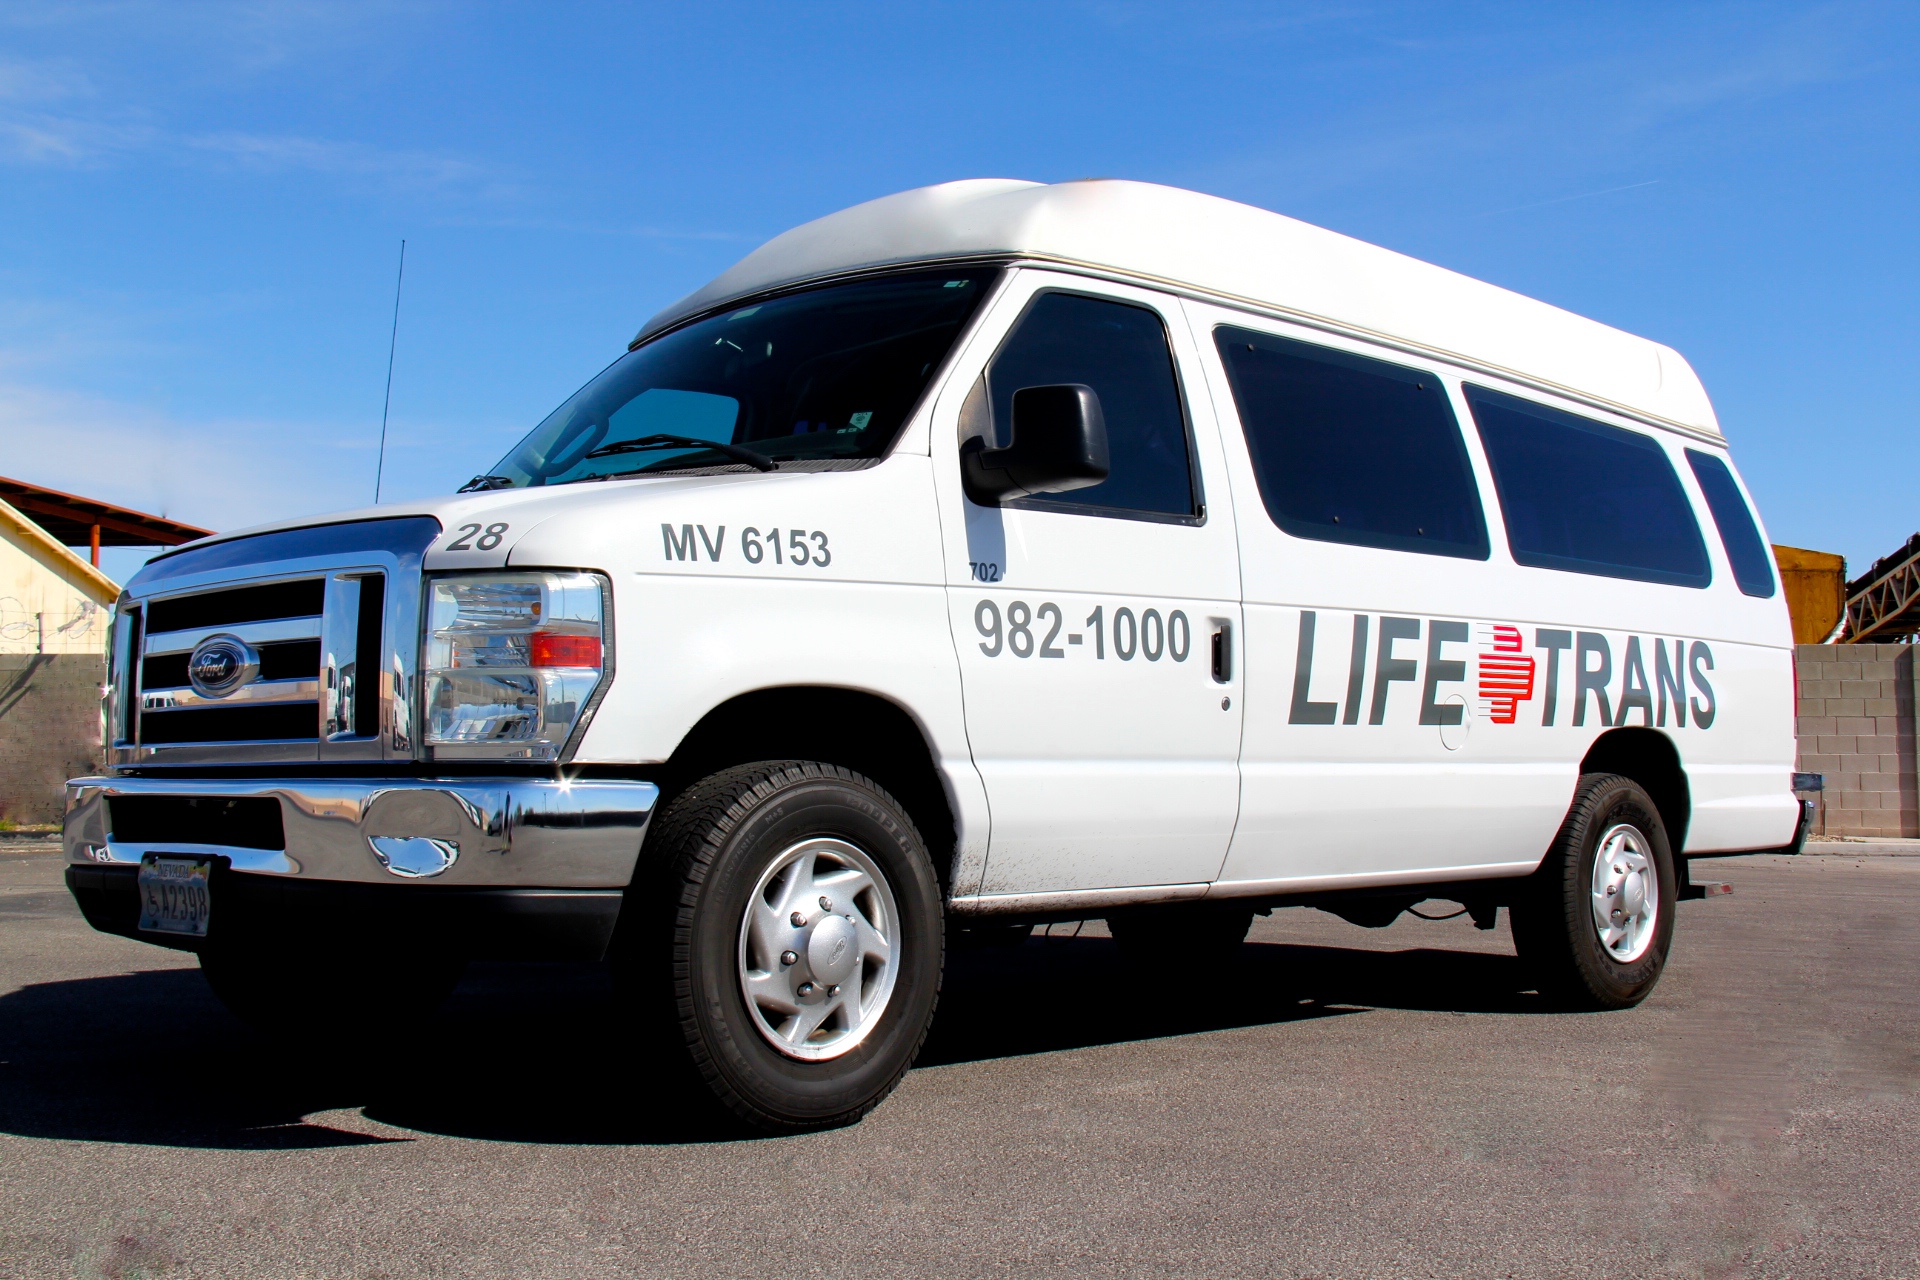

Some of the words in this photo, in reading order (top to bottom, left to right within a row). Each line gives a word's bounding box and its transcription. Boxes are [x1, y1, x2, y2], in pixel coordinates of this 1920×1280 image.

[446, 523, 510, 551] 28
[661, 523, 726, 562] MV
[741, 526, 831, 568] 6153
[969, 562, 998, 582] 702
[974, 599, 1191, 663] 982-1000
[197, 653, 228, 677] Ford
[1288, 611, 1469, 726] LIFE
[1534, 628, 1717, 730] TRANS
[764, 806, 785, 826] M+S
[158, 863, 190, 879] NEVADA
[161, 883, 207, 922] A2398
